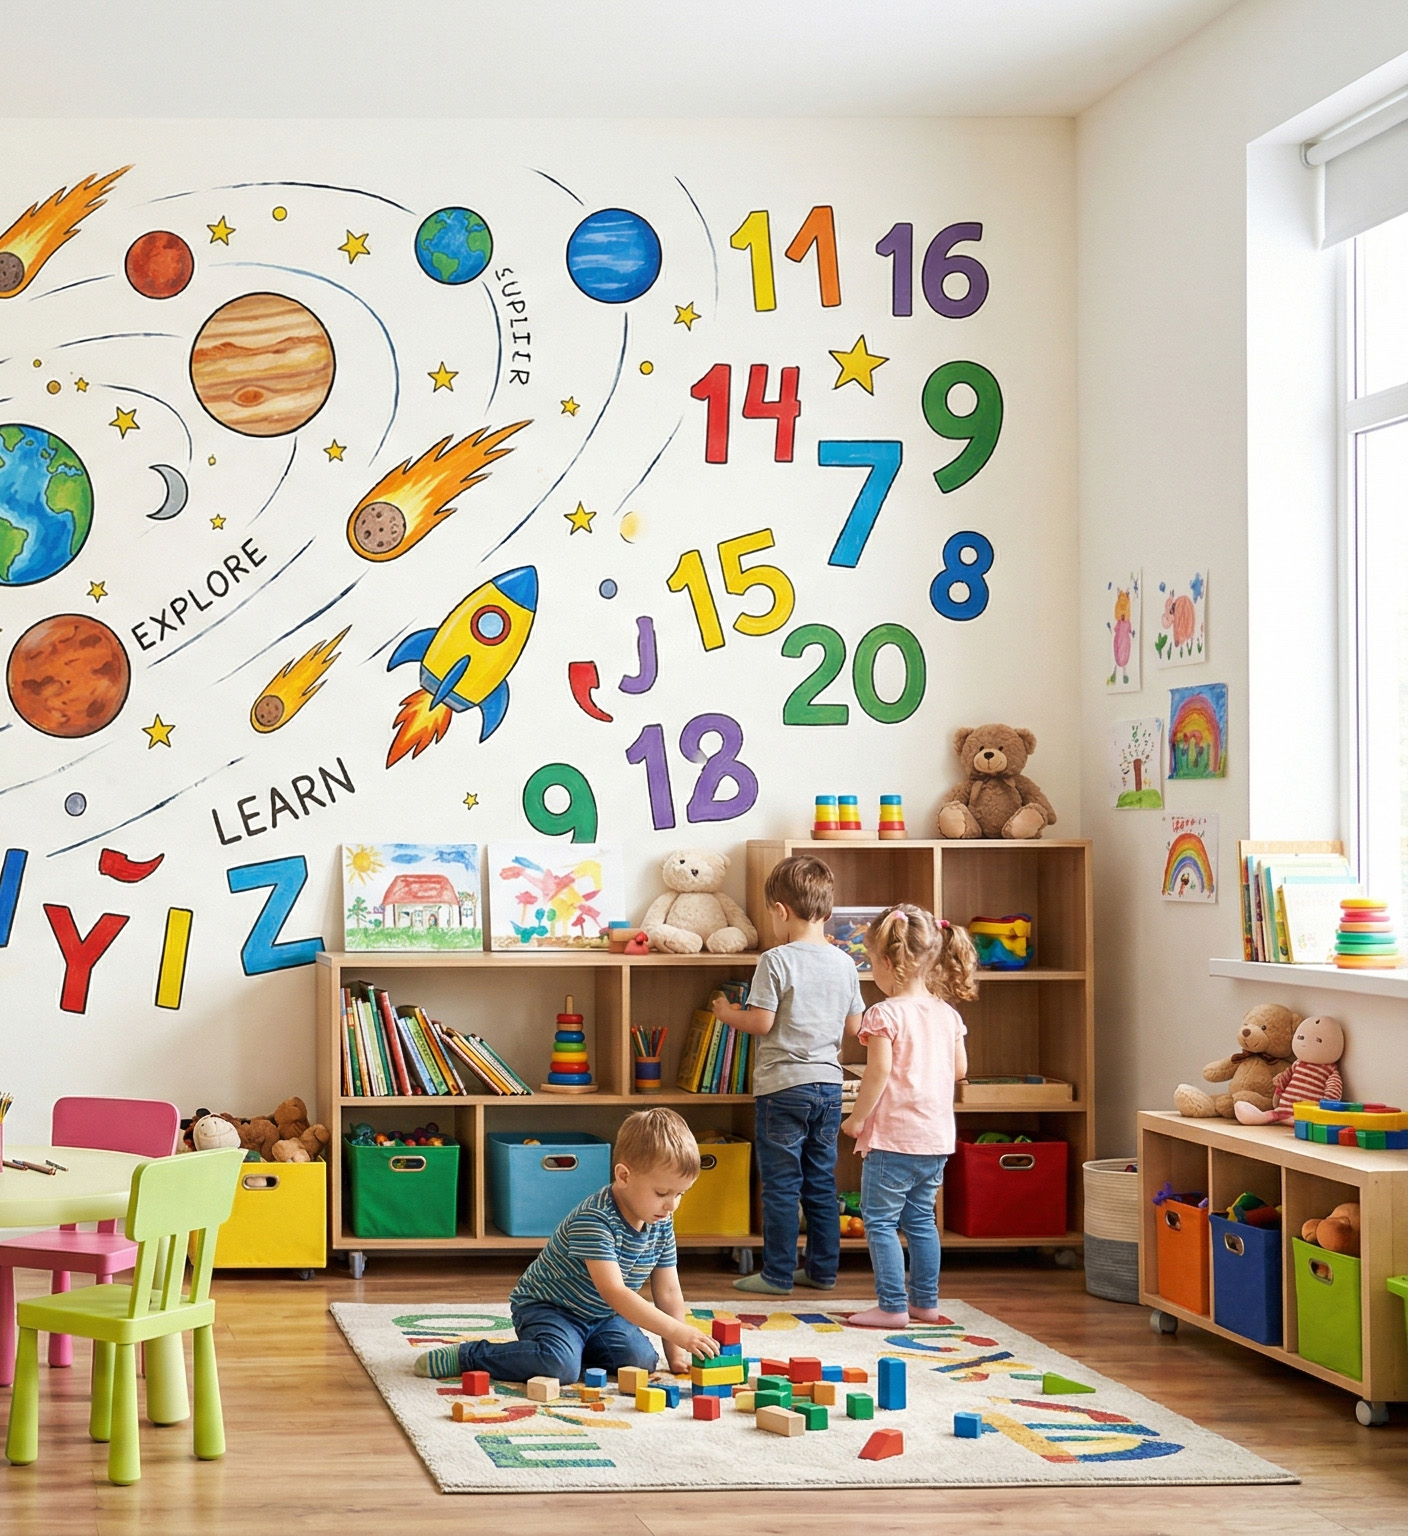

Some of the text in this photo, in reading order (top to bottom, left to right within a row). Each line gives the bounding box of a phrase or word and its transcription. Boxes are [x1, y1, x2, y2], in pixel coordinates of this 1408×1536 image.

[876, 222, 989, 319] 16
[691, 364, 801, 464] 14
[922, 361, 1003, 494] 9
[818, 440, 903, 568] 7
[132, 538, 267, 650] EXPLORE
[666, 528, 795, 652] 15
[930, 531, 994, 621] 8
[781, 623, 926, 726] 20
[212, 758, 355, 845] LEARN
[43, 904, 130, 1014] Y
[227, 855, 326, 976] Z
